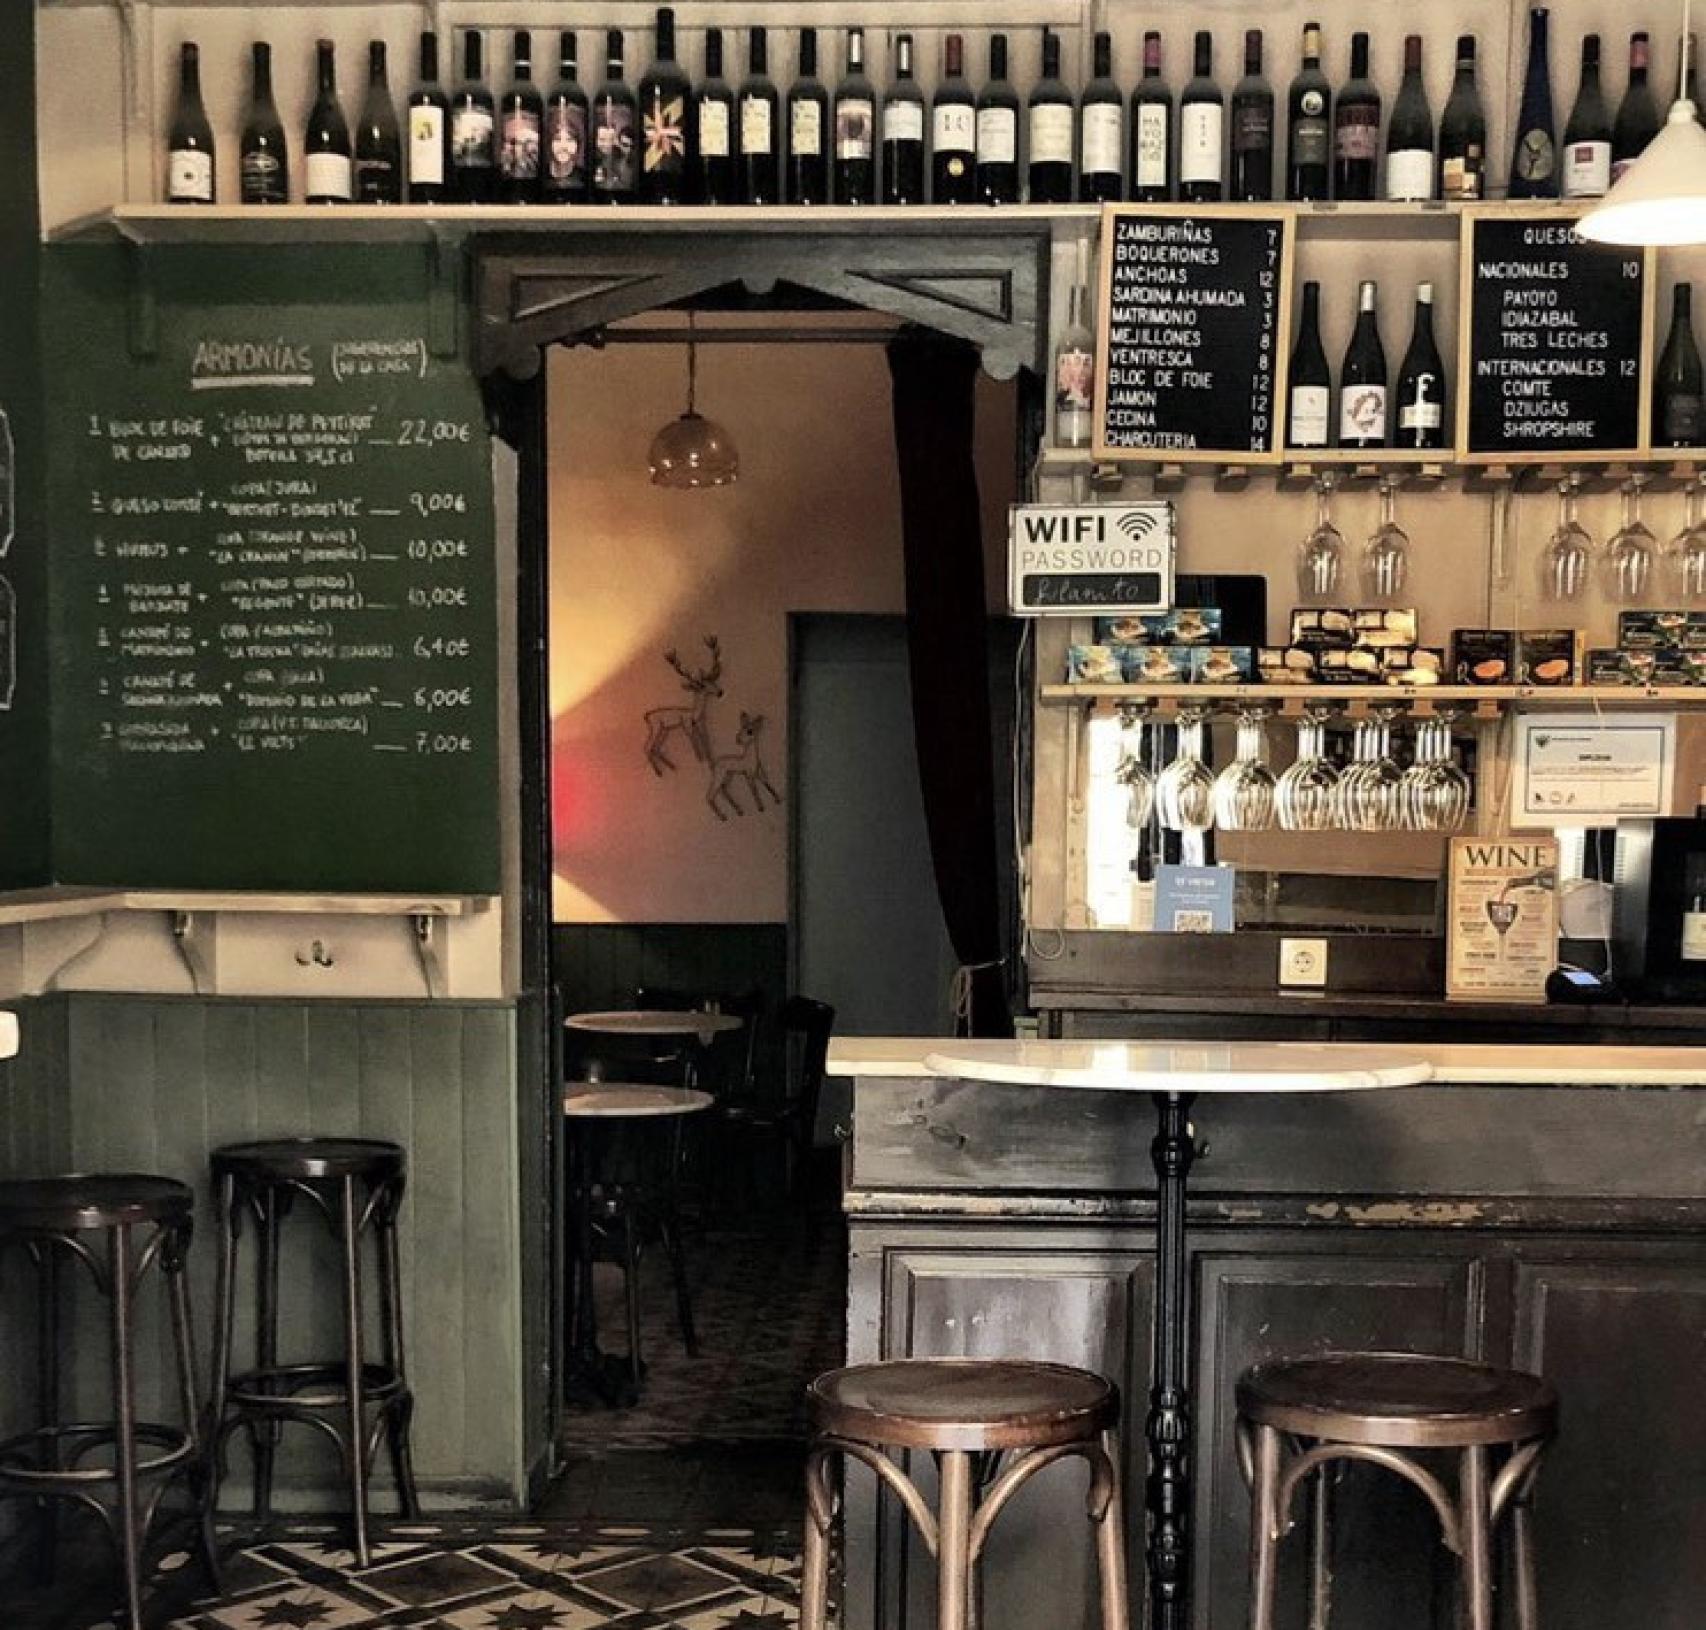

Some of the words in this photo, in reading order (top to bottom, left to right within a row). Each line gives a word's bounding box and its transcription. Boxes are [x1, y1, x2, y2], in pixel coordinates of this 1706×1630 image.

[1267, 229, 1277, 246] 7
[1116, 244, 1220, 265] BOQUERONES
[1267, 251, 1277, 267] 7
[1115, 266, 1188, 284] ANCHOAS
[1478, 262, 1568, 278] NACIONALES
[1622, 262, 1640, 278] 10
[1113, 286, 1172, 304] SARDINA
[1176, 289, 1246, 306] AHUMADA
[1112, 307, 1197, 325] MATRIMONIO
[1501, 310, 1579, 327] IDIAZABAL
[1111, 328, 1201, 347] MEJILLONES
[1501, 332, 1538, 348] TRES
[1547, 332, 1608, 348] LECHES
[191, 339, 314, 373] ARMONÍAS
[1111, 349, 1193, 366] VENTRESCA
[1478, 359, 1606, 376] INTERNACIONALES
[1620, 361, 1636, 377] 12
[1110, 369, 1146, 385] BLOC
[1154, 370, 1174, 387] DE
[1181, 371, 1213, 389] FOIE
[1252, 374, 1270, 391] 12
[1502, 380, 1552, 396] COMTE
[1110, 390, 1157, 406] JAMON
[1252, 395, 1268, 412] 12
[1108, 409, 1156, 426] CECINA
[1252, 415, 1268, 432] 10
[1503, 421, 1595, 437] SHROPSHIRE
[398, 418, 471, 447] 22,00€
[410, 493, 466, 519] 9,00€
[1024, 516, 1105, 543] WIFI
[1022, 550, 1162, 569] PASSWORD
[413, 688, 471, 713] 6,00€
[415, 730, 471, 752] 7,00€
[1465, 845, 1547, 867] WINE
